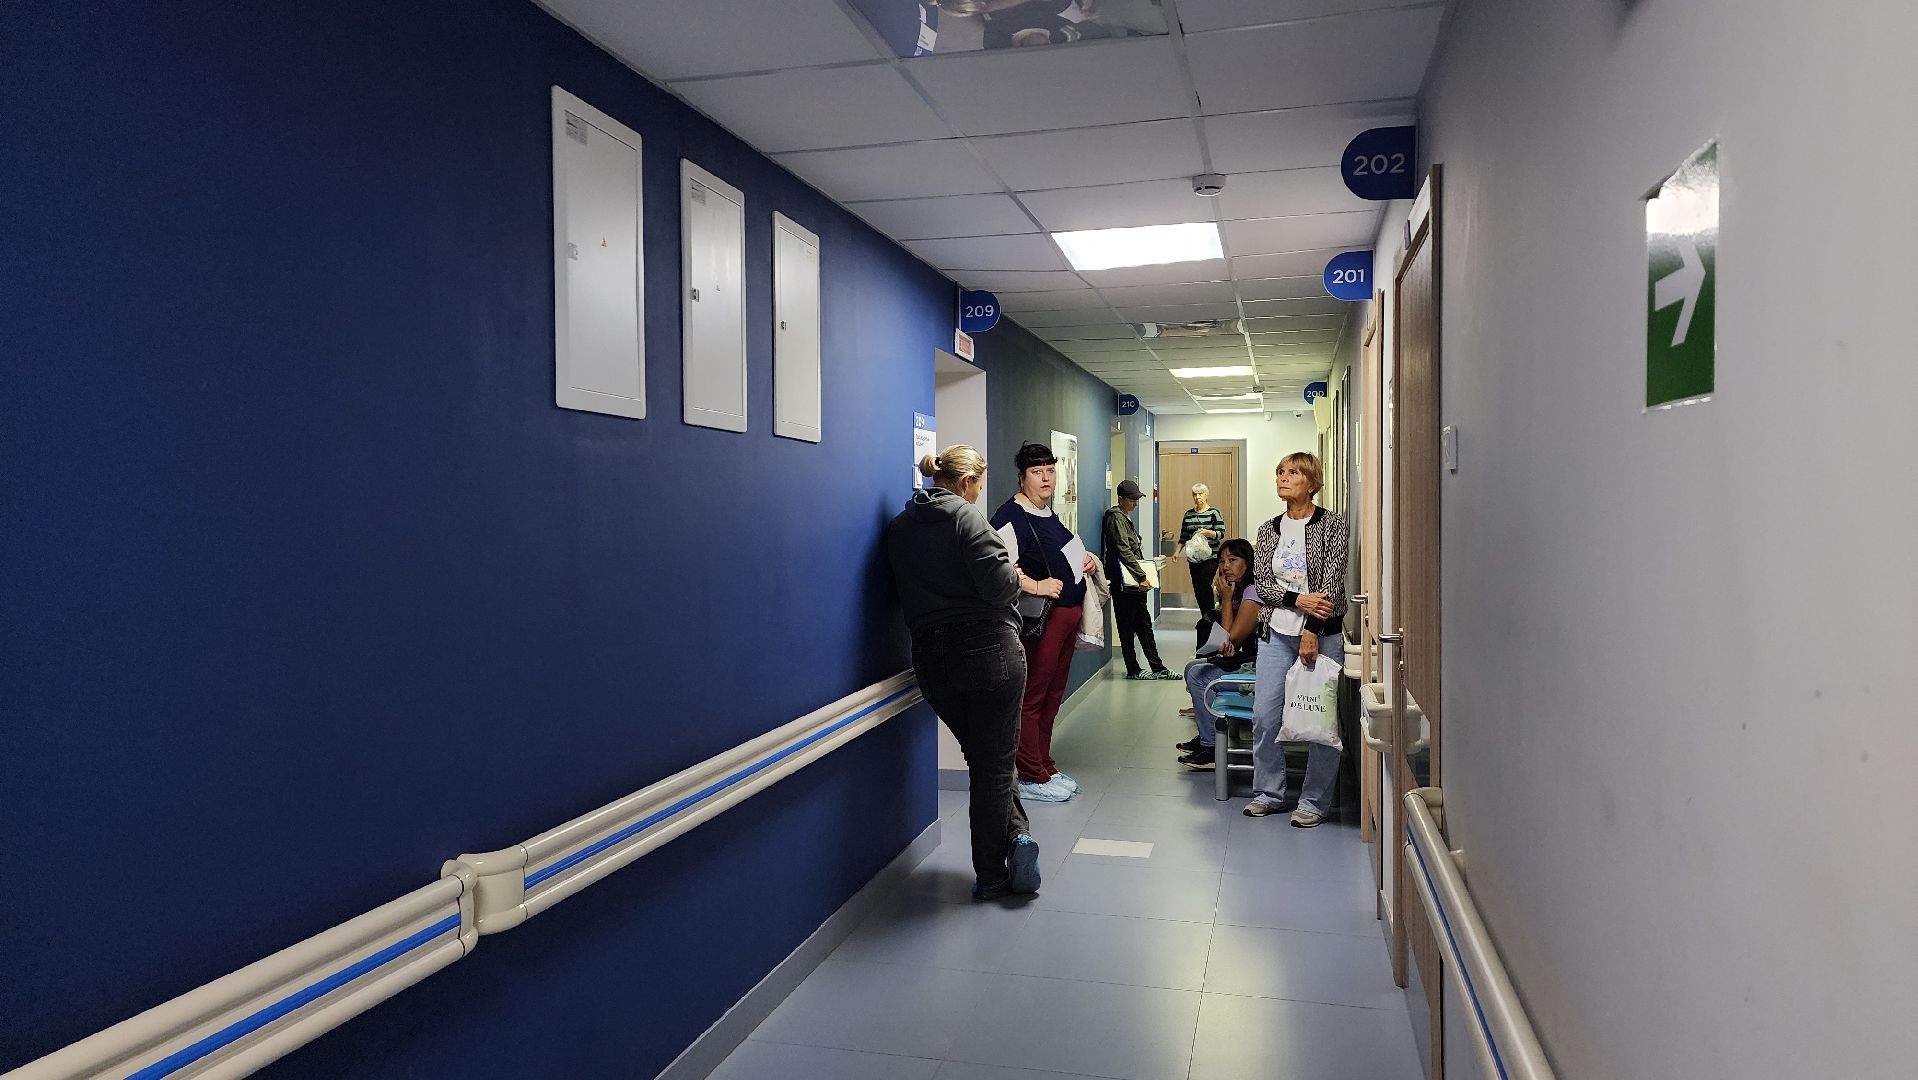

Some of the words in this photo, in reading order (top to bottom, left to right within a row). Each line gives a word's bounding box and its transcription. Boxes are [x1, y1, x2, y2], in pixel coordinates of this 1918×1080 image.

[1353, 152, 1405, 176] 202
[1333, 268, 1365, 284] 201
[965, 304, 994, 318] 209
[1304, 704, 1327, 712] LUXE
